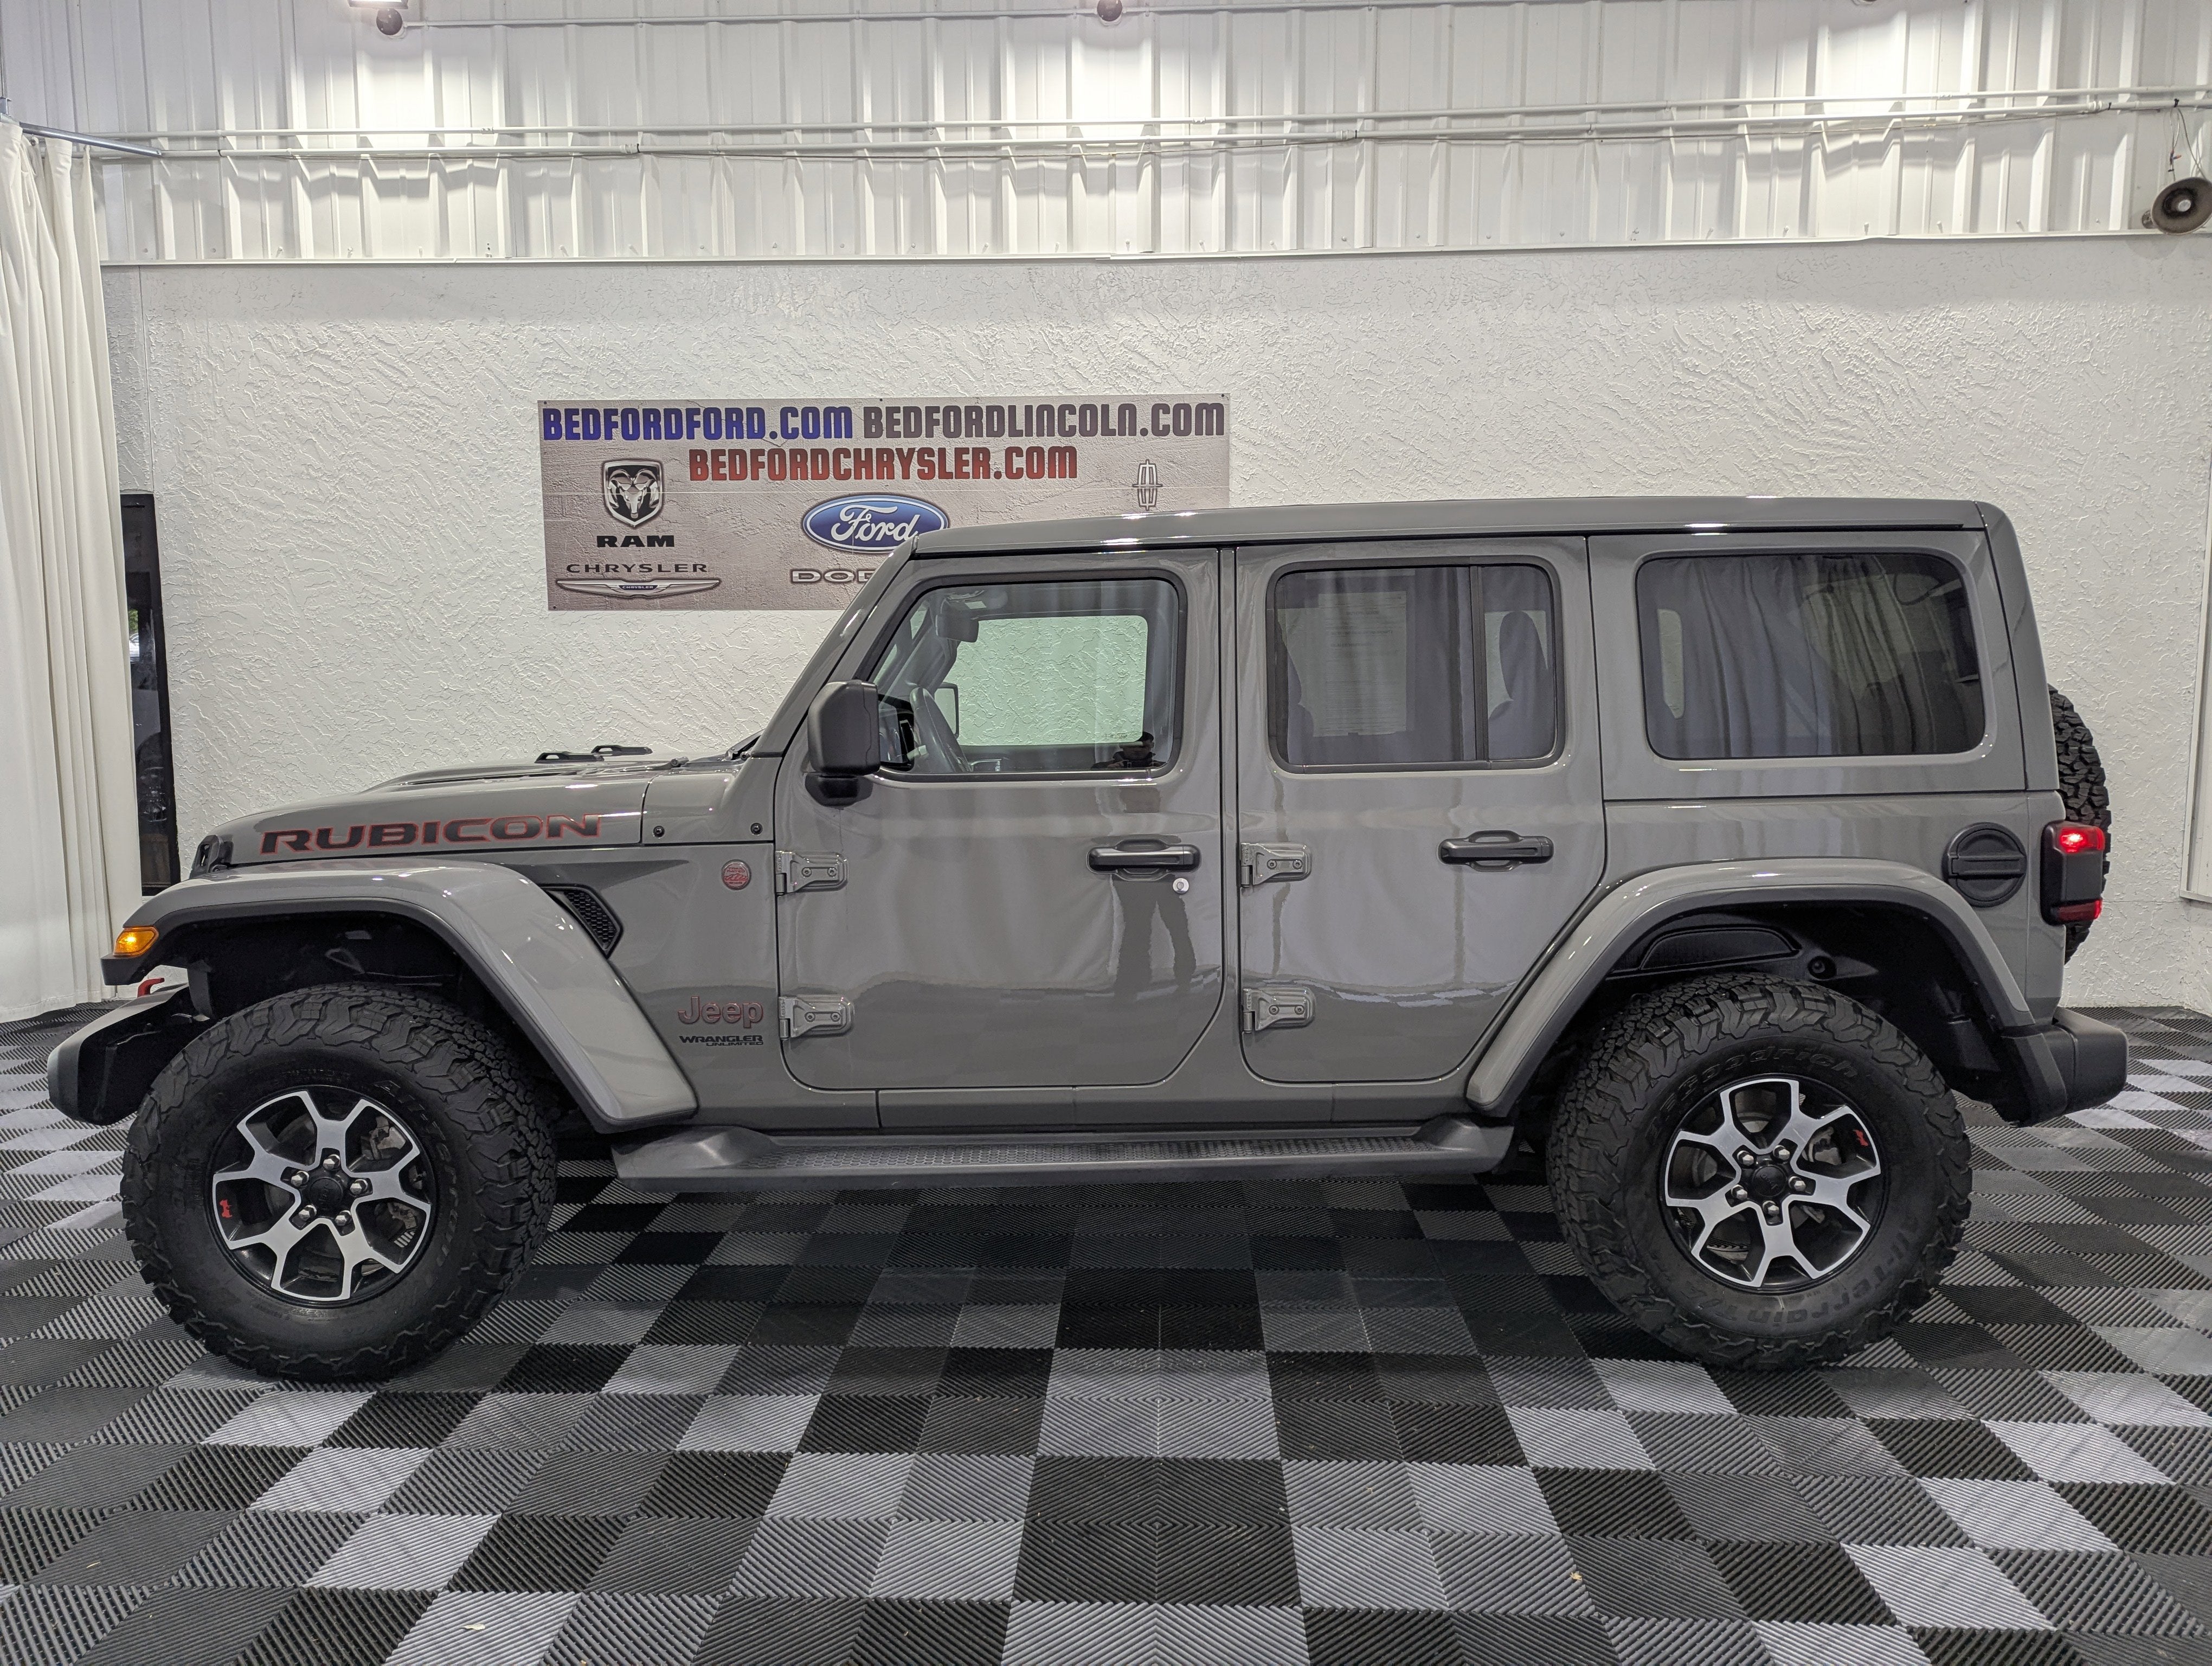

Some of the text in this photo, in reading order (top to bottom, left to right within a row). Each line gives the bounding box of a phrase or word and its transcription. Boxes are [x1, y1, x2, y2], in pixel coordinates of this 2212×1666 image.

[543, 403, 1224, 440] BEDFORDFORD.COM BEDFORDLINCOLN.COM
[690, 447, 1077, 480] BEDFORDCHRYSLER.COM
[830, 505, 918, 542] Ford
[597, 535, 674, 548] RAM
[566, 563, 707, 573] CHRYSLER
[261, 813, 601, 854] RUBICON
[678, 996, 764, 1029] Jeep
[678, 1035, 763, 1043] WRANGLER
